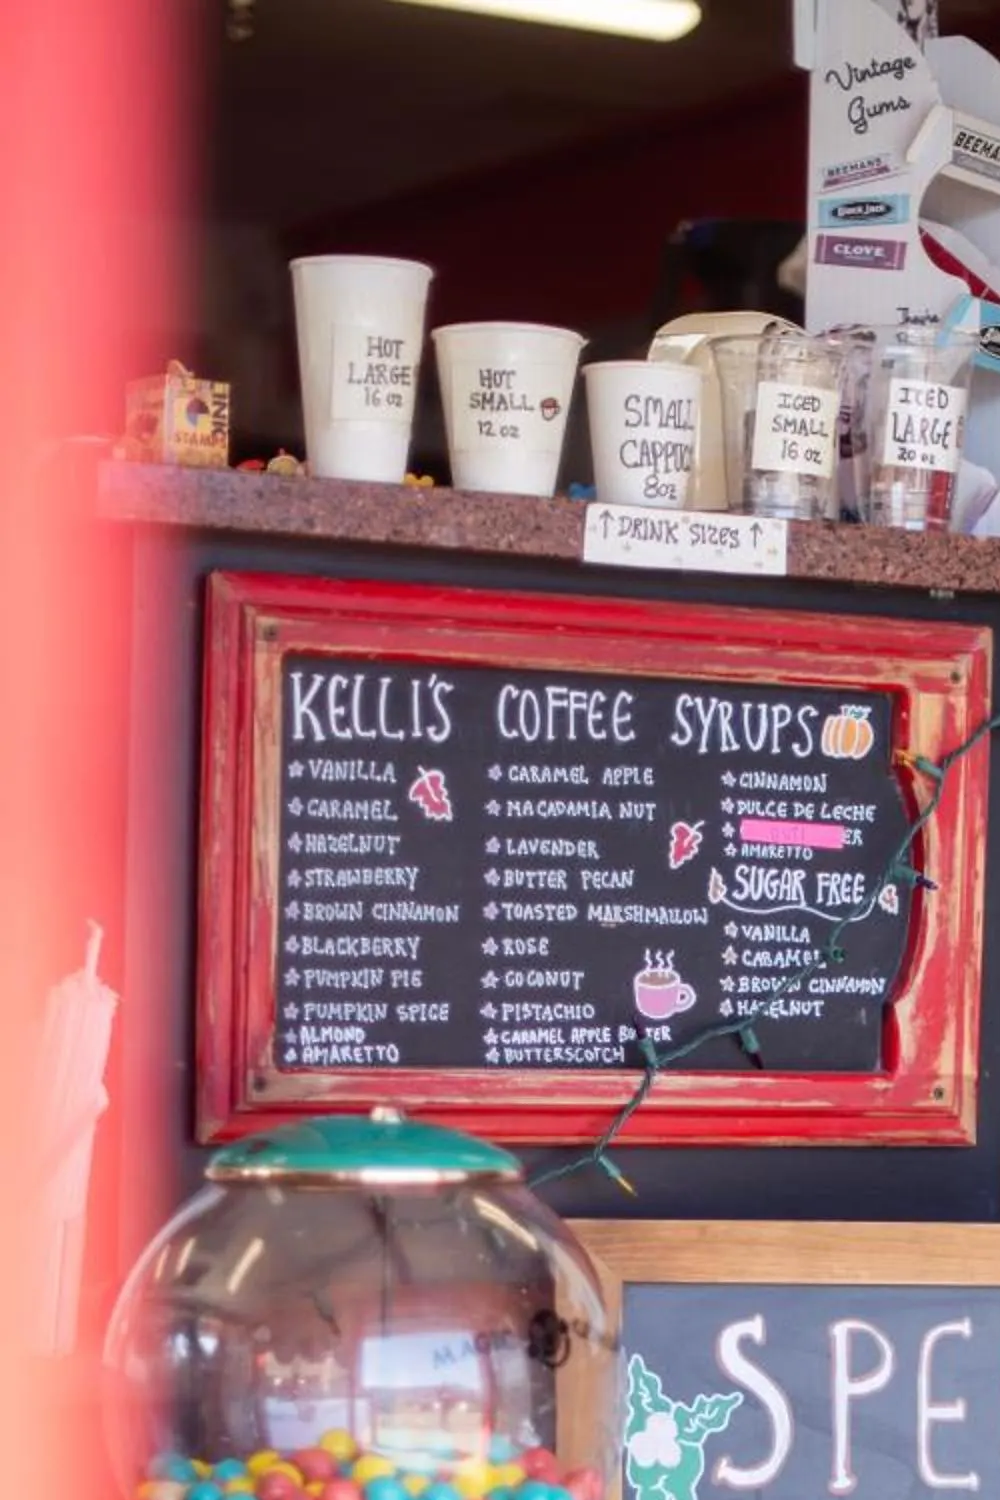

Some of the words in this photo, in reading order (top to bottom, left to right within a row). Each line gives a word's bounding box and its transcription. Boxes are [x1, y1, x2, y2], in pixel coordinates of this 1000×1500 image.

[825, 54, 916, 92] Vintage
[847, 95, 911, 134] Gums
[826, 157, 882, 177] BEEMANS
[833, 243, 885, 257] CLOVE
[367, 336, 404, 359] HOT
[348, 362, 412, 386] LARGE
[479, 369, 517, 389] HOT
[364, 386, 381, 407] 16
[469, 392, 535, 413] SMALL
[777, 393, 821, 412] ICED
[899, 387, 949, 409] ICED
[624, 394, 694, 430] SMALL
[477, 420, 496, 437] 12
[771, 418, 829, 439] SMALL
[892, 411, 952, 450] LARGE
[780, 443, 797, 461] 16
[897, 447, 916, 461] 20
[617, 515, 679, 544] DRINK
[290, 671, 455, 743] KELLI'S
[498, 683, 637, 742] COFFEE
[671, 694, 819, 758] SYRUPS
[308, 758, 397, 783] VANILLA
[508, 765, 589, 785] CARAMEL
[602, 766, 655, 787] APPLE
[739, 771, 828, 792] CINNAMON
[307, 800, 398, 821] CARAMEL
[507, 801, 612, 819] MACADAMIA
[620, 802, 656, 820] NUT
[737, 800, 787, 817] DULCE
[793, 801, 814, 818] DE
[820, 802, 876, 821] LECHE
[304, 834, 400, 856] HAZELNUT
[506, 838, 600, 860] LAVENDER
[741, 843, 813, 861] AMARETTO
[304, 866, 419, 891] STRAWBERRY
[503, 869, 567, 889] BUTTER
[581, 870, 635, 890] PECAN
[733, 865, 806, 906] SUGAR
[816, 871, 866, 905] FREE
[303, 903, 364, 922] BROWN
[372, 903, 459, 923] CINNAMON
[502, 903, 578, 921] TOASTED
[587, 903, 708, 925] MARSHMALLOW
[741, 925, 811, 943] VANILLA
[302, 935, 421, 960] BLACKBERRY
[503, 937, 549, 957] ROSE
[304, 969, 384, 990] PUMPKIN
[390, 969, 423, 989] PIE
[505, 970, 585, 991] COCONUT
[808, 975, 886, 995] CINNAMON
[304, 1002, 388, 1023] PUMPKIN
[398, 1002, 450, 1022] SPICE
[502, 1003, 595, 1021] PISTACHIO
[300, 1026, 366, 1045] ALMOND
[501, 1028, 565, 1044] CARAMEL
[571, 1027, 612, 1043] APPLE
[619, 1025, 672, 1043] BUTER
[302, 1044, 400, 1065] AMARETTO
[504, 1047, 625, 1063] BUTTERSCOTCH
